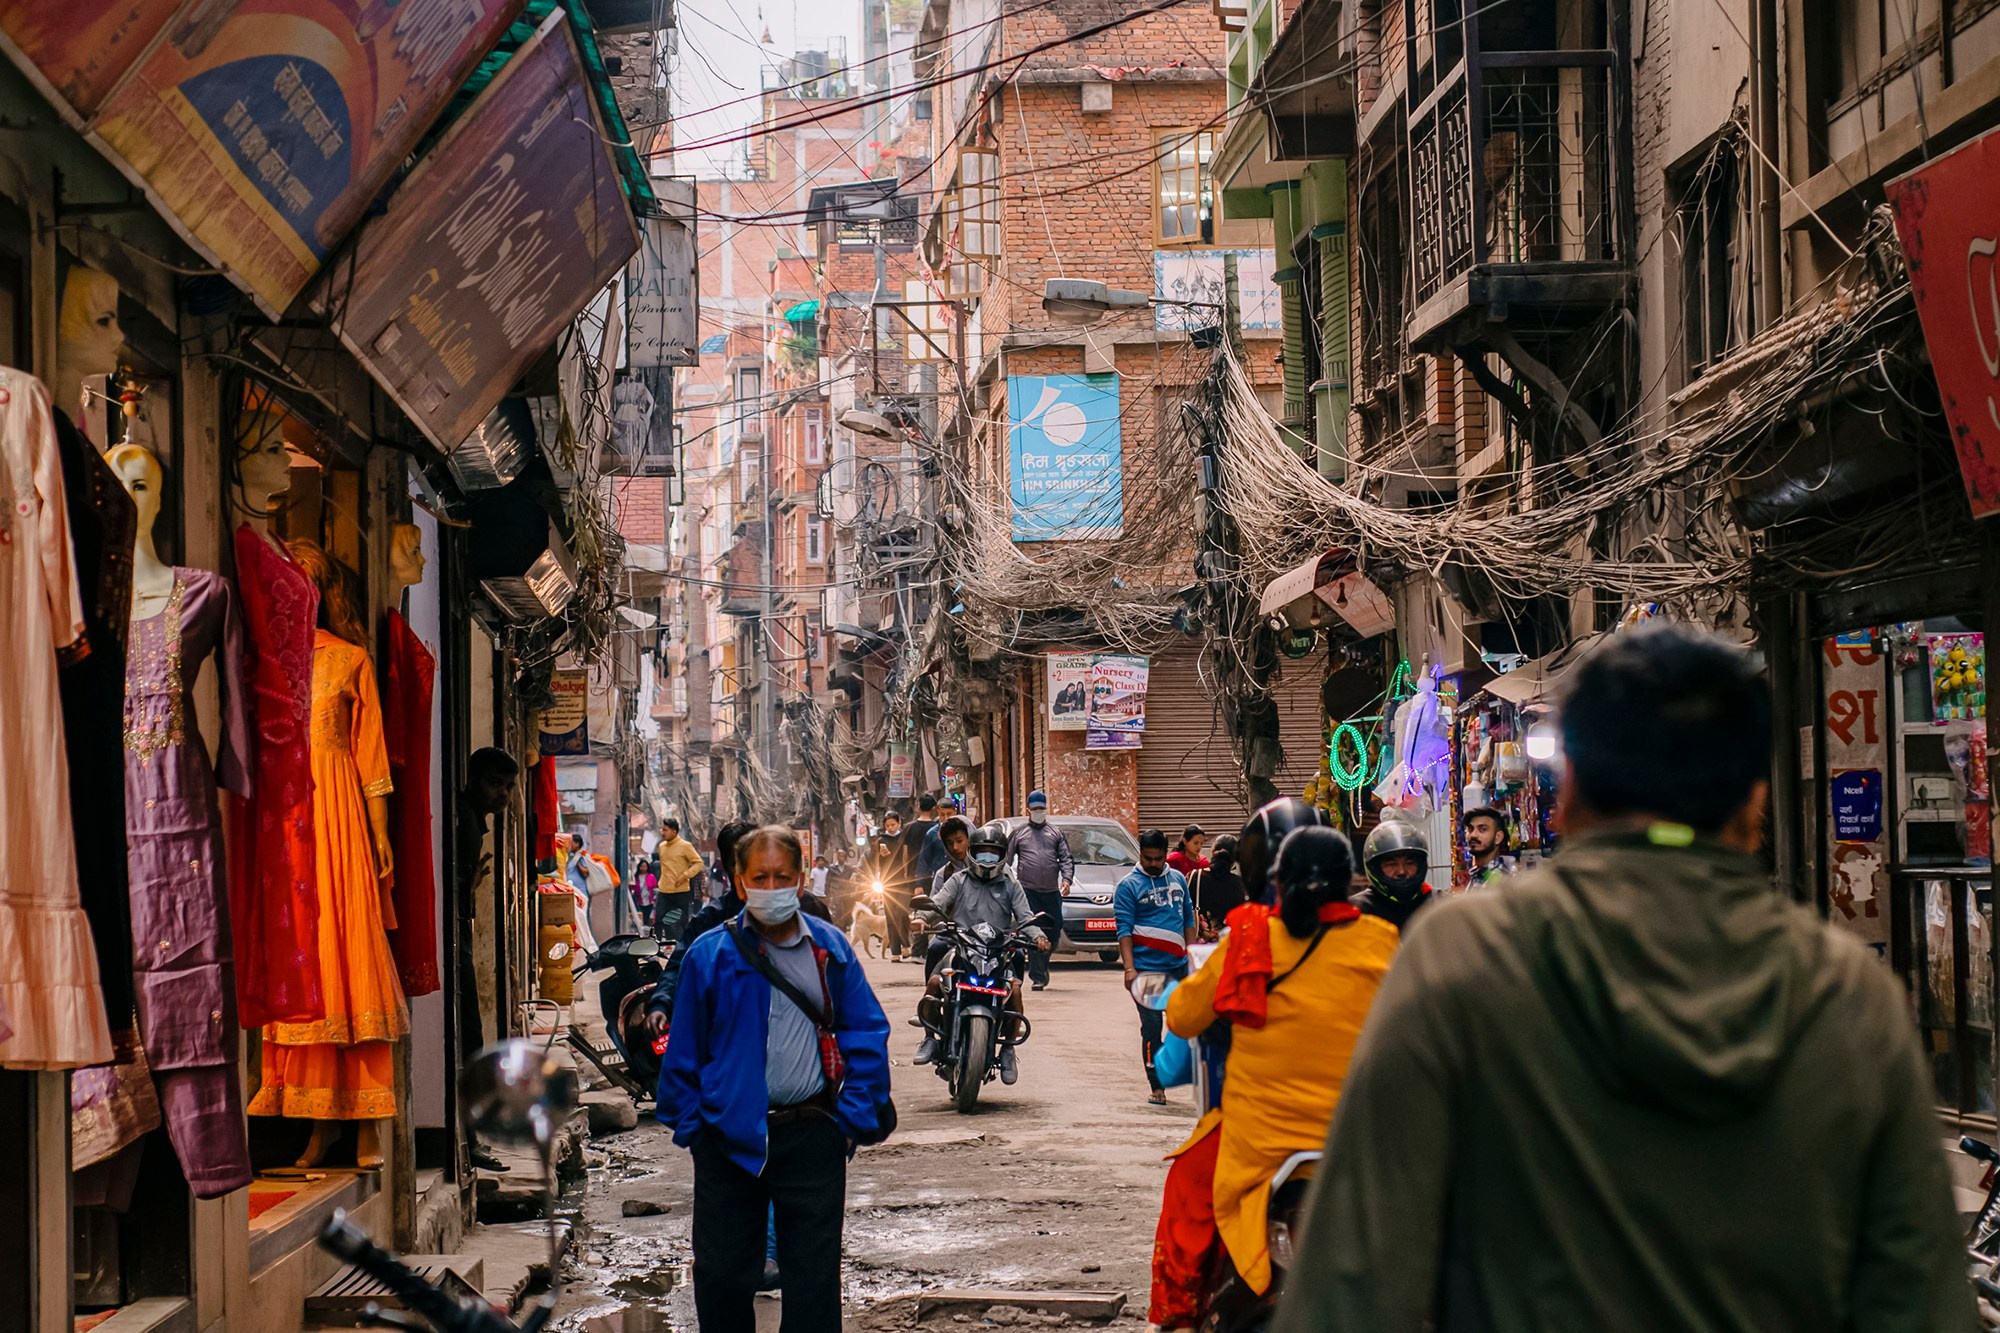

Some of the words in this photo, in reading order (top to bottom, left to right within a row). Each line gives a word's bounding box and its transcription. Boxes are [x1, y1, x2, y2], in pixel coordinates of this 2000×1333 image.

[426, 152, 529, 270] Riddhi
[456, 209, 551, 313] Siddhi
[496, 252, 563, 349] Ladies
[637, 304, 682, 313] Parlour
[388, 268, 449, 339] Fashion
[438, 322, 478, 388] Collection
[1021, 452, 1049, 470] हिम
[1021, 480, 1043, 491] HIM
[1095, 666, 1134, 679] Nursery
[551, 681, 586, 694] Shakya
[1115, 680, 1135, 690] Class
[1843, 786, 1864, 795] Ncell
